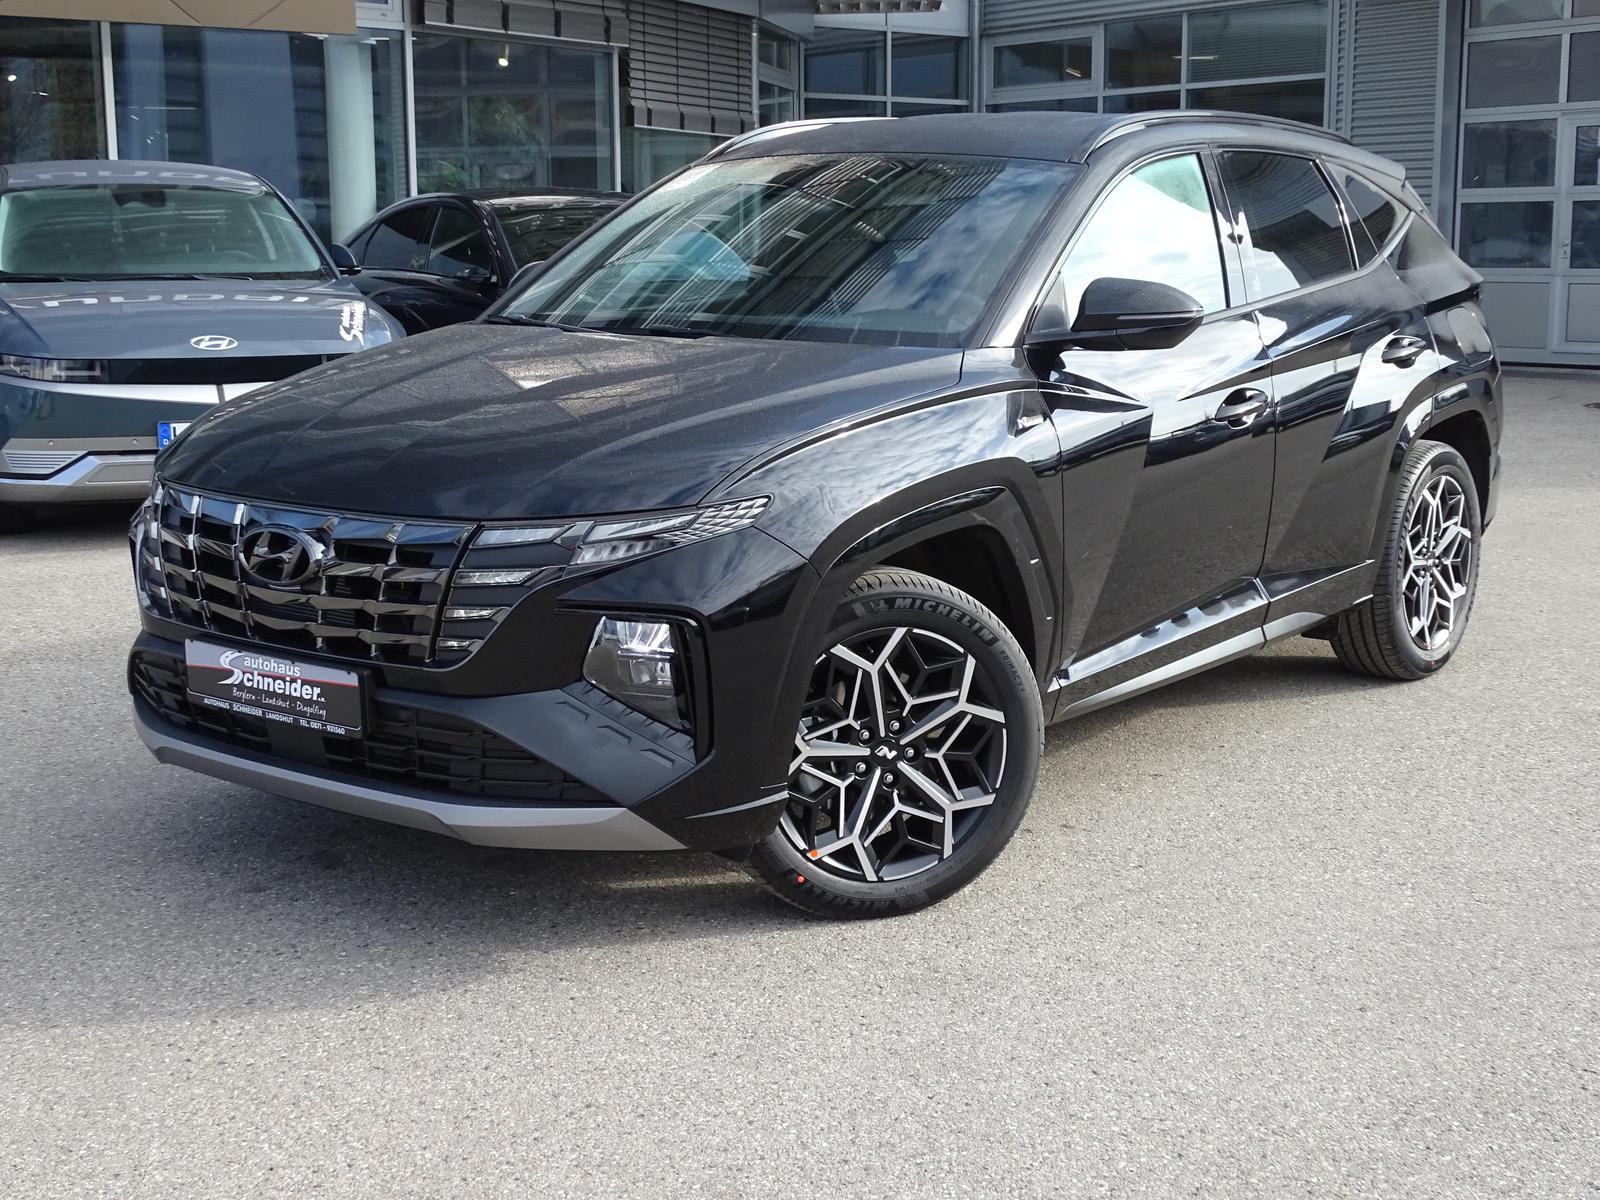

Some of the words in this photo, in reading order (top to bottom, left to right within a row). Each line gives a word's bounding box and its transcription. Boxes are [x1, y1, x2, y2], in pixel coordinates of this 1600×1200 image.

[893, 597, 995, 643] MICHELIN
[244, 656, 302, 677] autohaus
[203, 697, 230, 710] AUTOHAUS
[232, 703, 263, 717] SCHNEIDER
[265, 711, 294, 724] LANDSHUT
